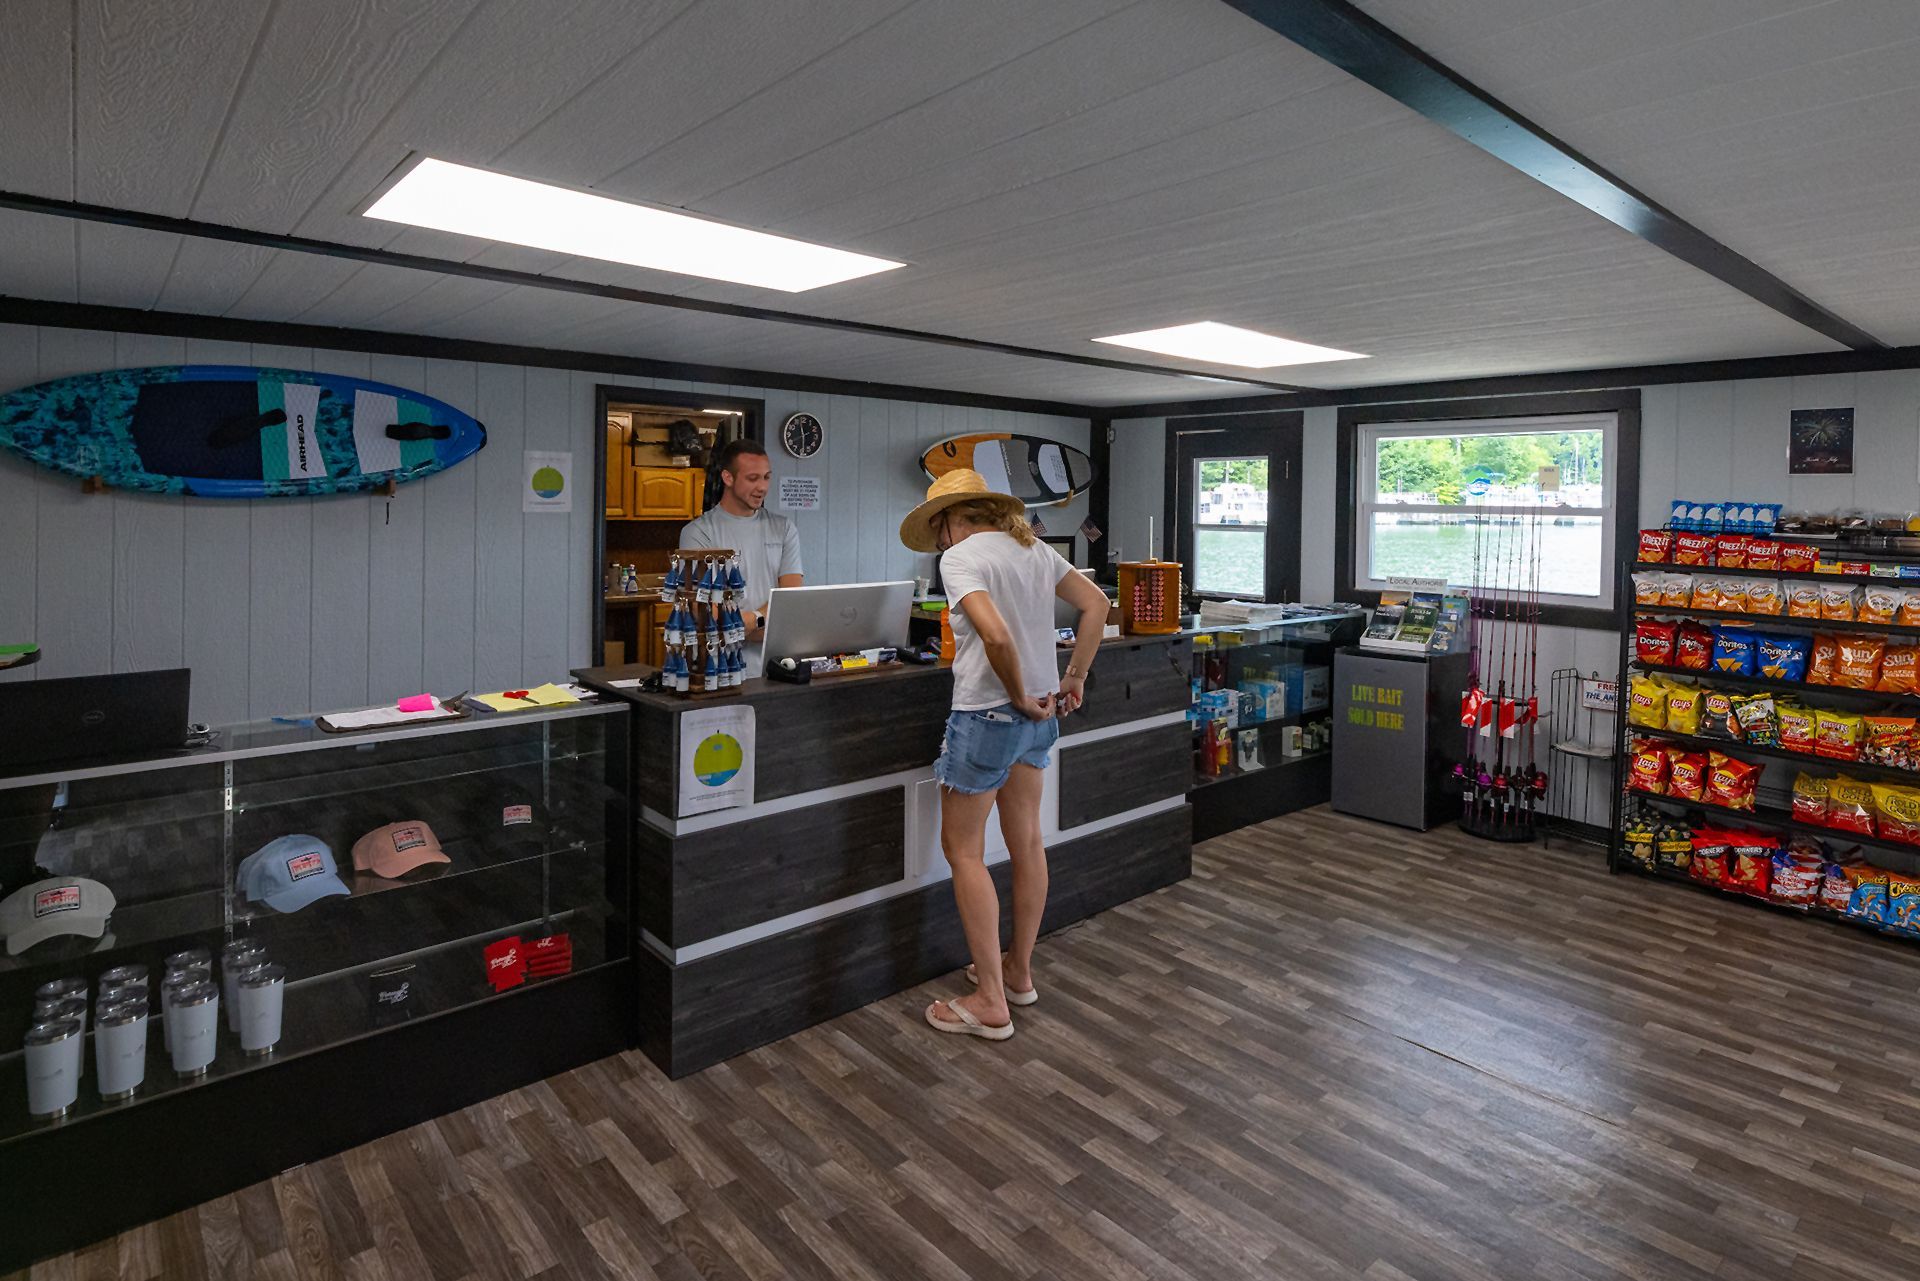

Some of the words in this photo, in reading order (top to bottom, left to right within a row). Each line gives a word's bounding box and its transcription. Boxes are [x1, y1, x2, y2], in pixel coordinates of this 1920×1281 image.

[297, 414, 307, 472] AIRHEAD
[1390, 578, 1410, 586] LOCAL
[1412, 578, 1444, 587] AUTHORS
[1639, 637, 1670, 648] Doritos
[1681, 637, 1704, 651] Doritos
[1718, 639, 1748, 650] Doritos
[1760, 646, 1791, 656] Doritos
[1819, 646, 1836, 659] Su
[1883, 654, 1911, 667] Sun
[1352, 684, 1375, 704] LIVE
[1377, 687, 1403, 706] BAIT
[1585, 691, 1601, 700] THE
[1348, 706, 1374, 726] SOLD
[1376, 711, 1405, 731] HERE
[1841, 793, 1871, 803] GOLD
[1889, 806, 1917, 817] GOLD
